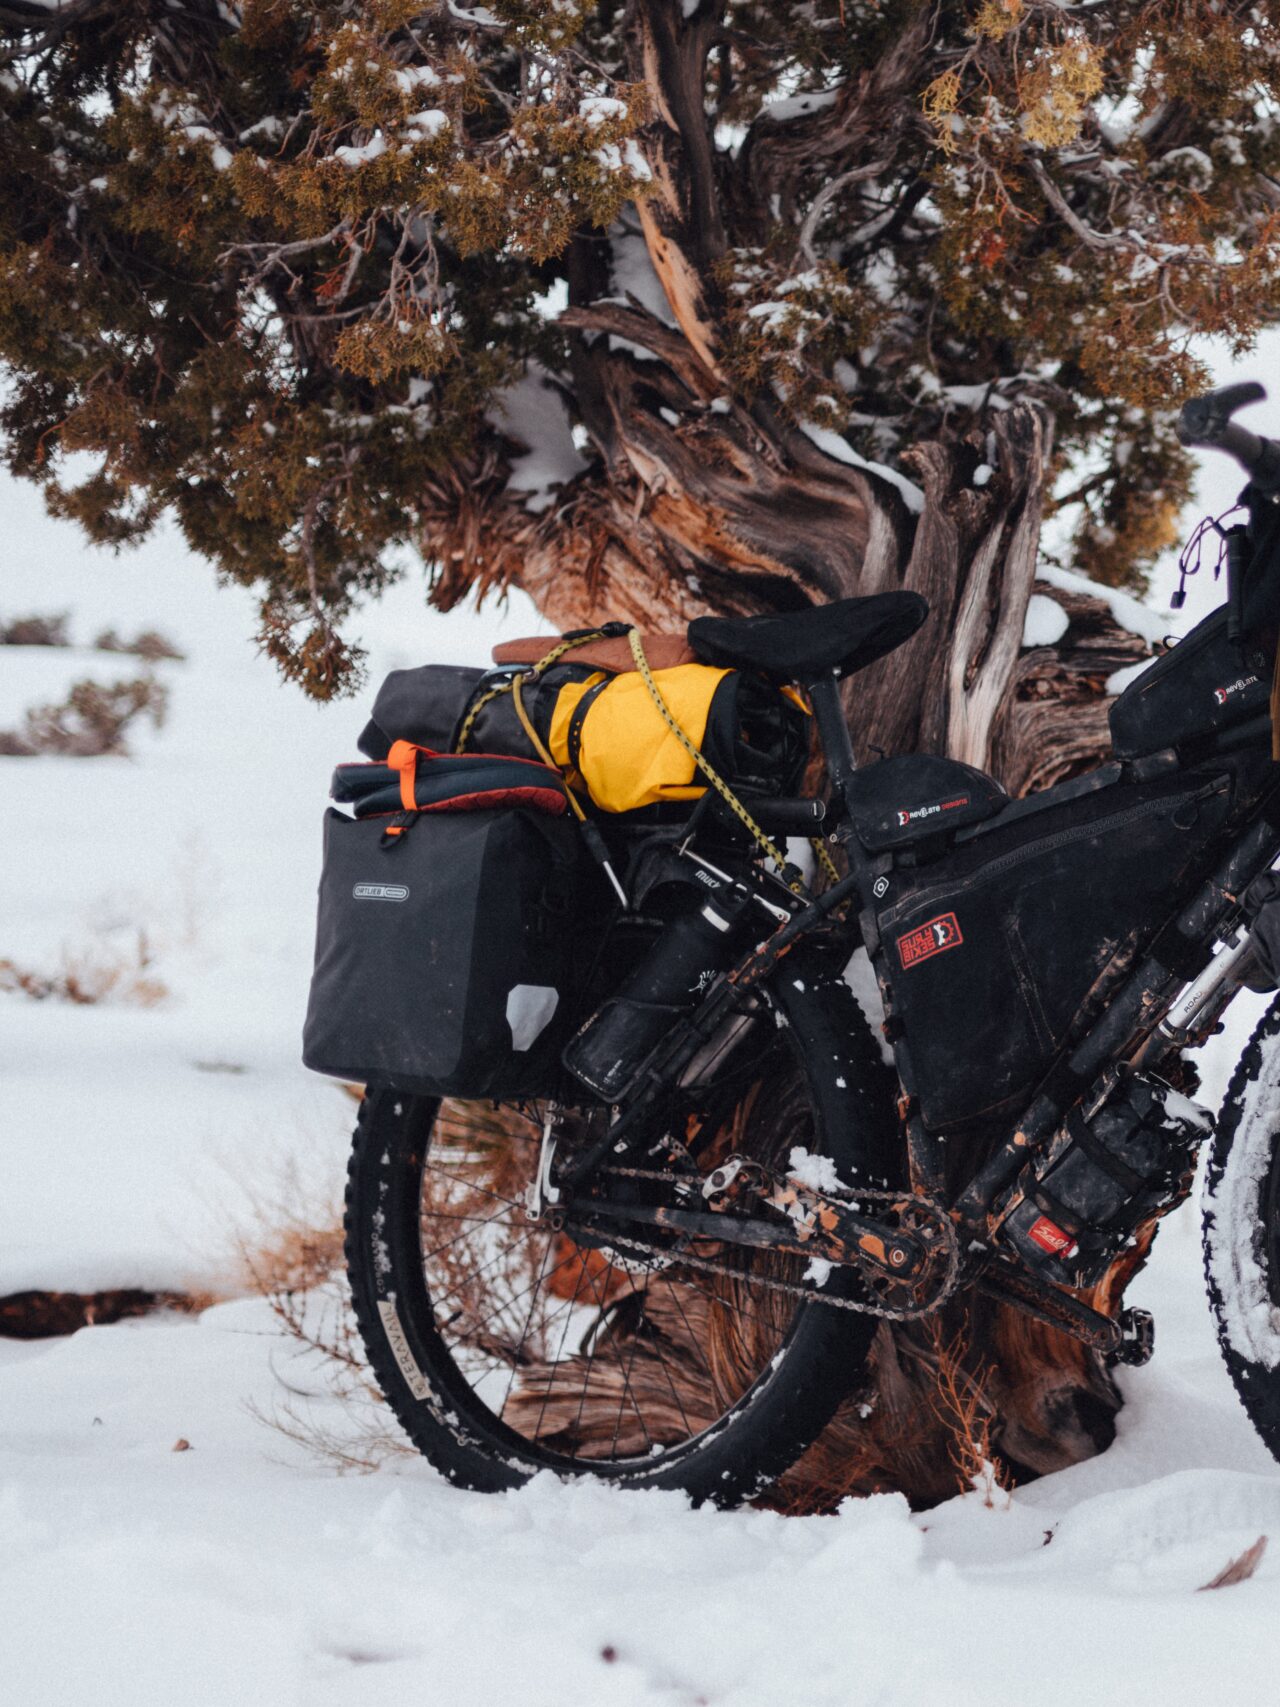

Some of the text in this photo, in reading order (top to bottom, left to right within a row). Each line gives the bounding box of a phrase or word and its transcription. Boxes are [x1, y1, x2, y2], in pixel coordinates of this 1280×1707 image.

[356, 887, 382, 895] ORTLIEB
[901, 927, 934, 950] SURLY
[903, 937, 937, 964] BIKES
[1183, 991, 1203, 1014] ROAD
[383, 1304, 418, 1384] TERAVAIL
